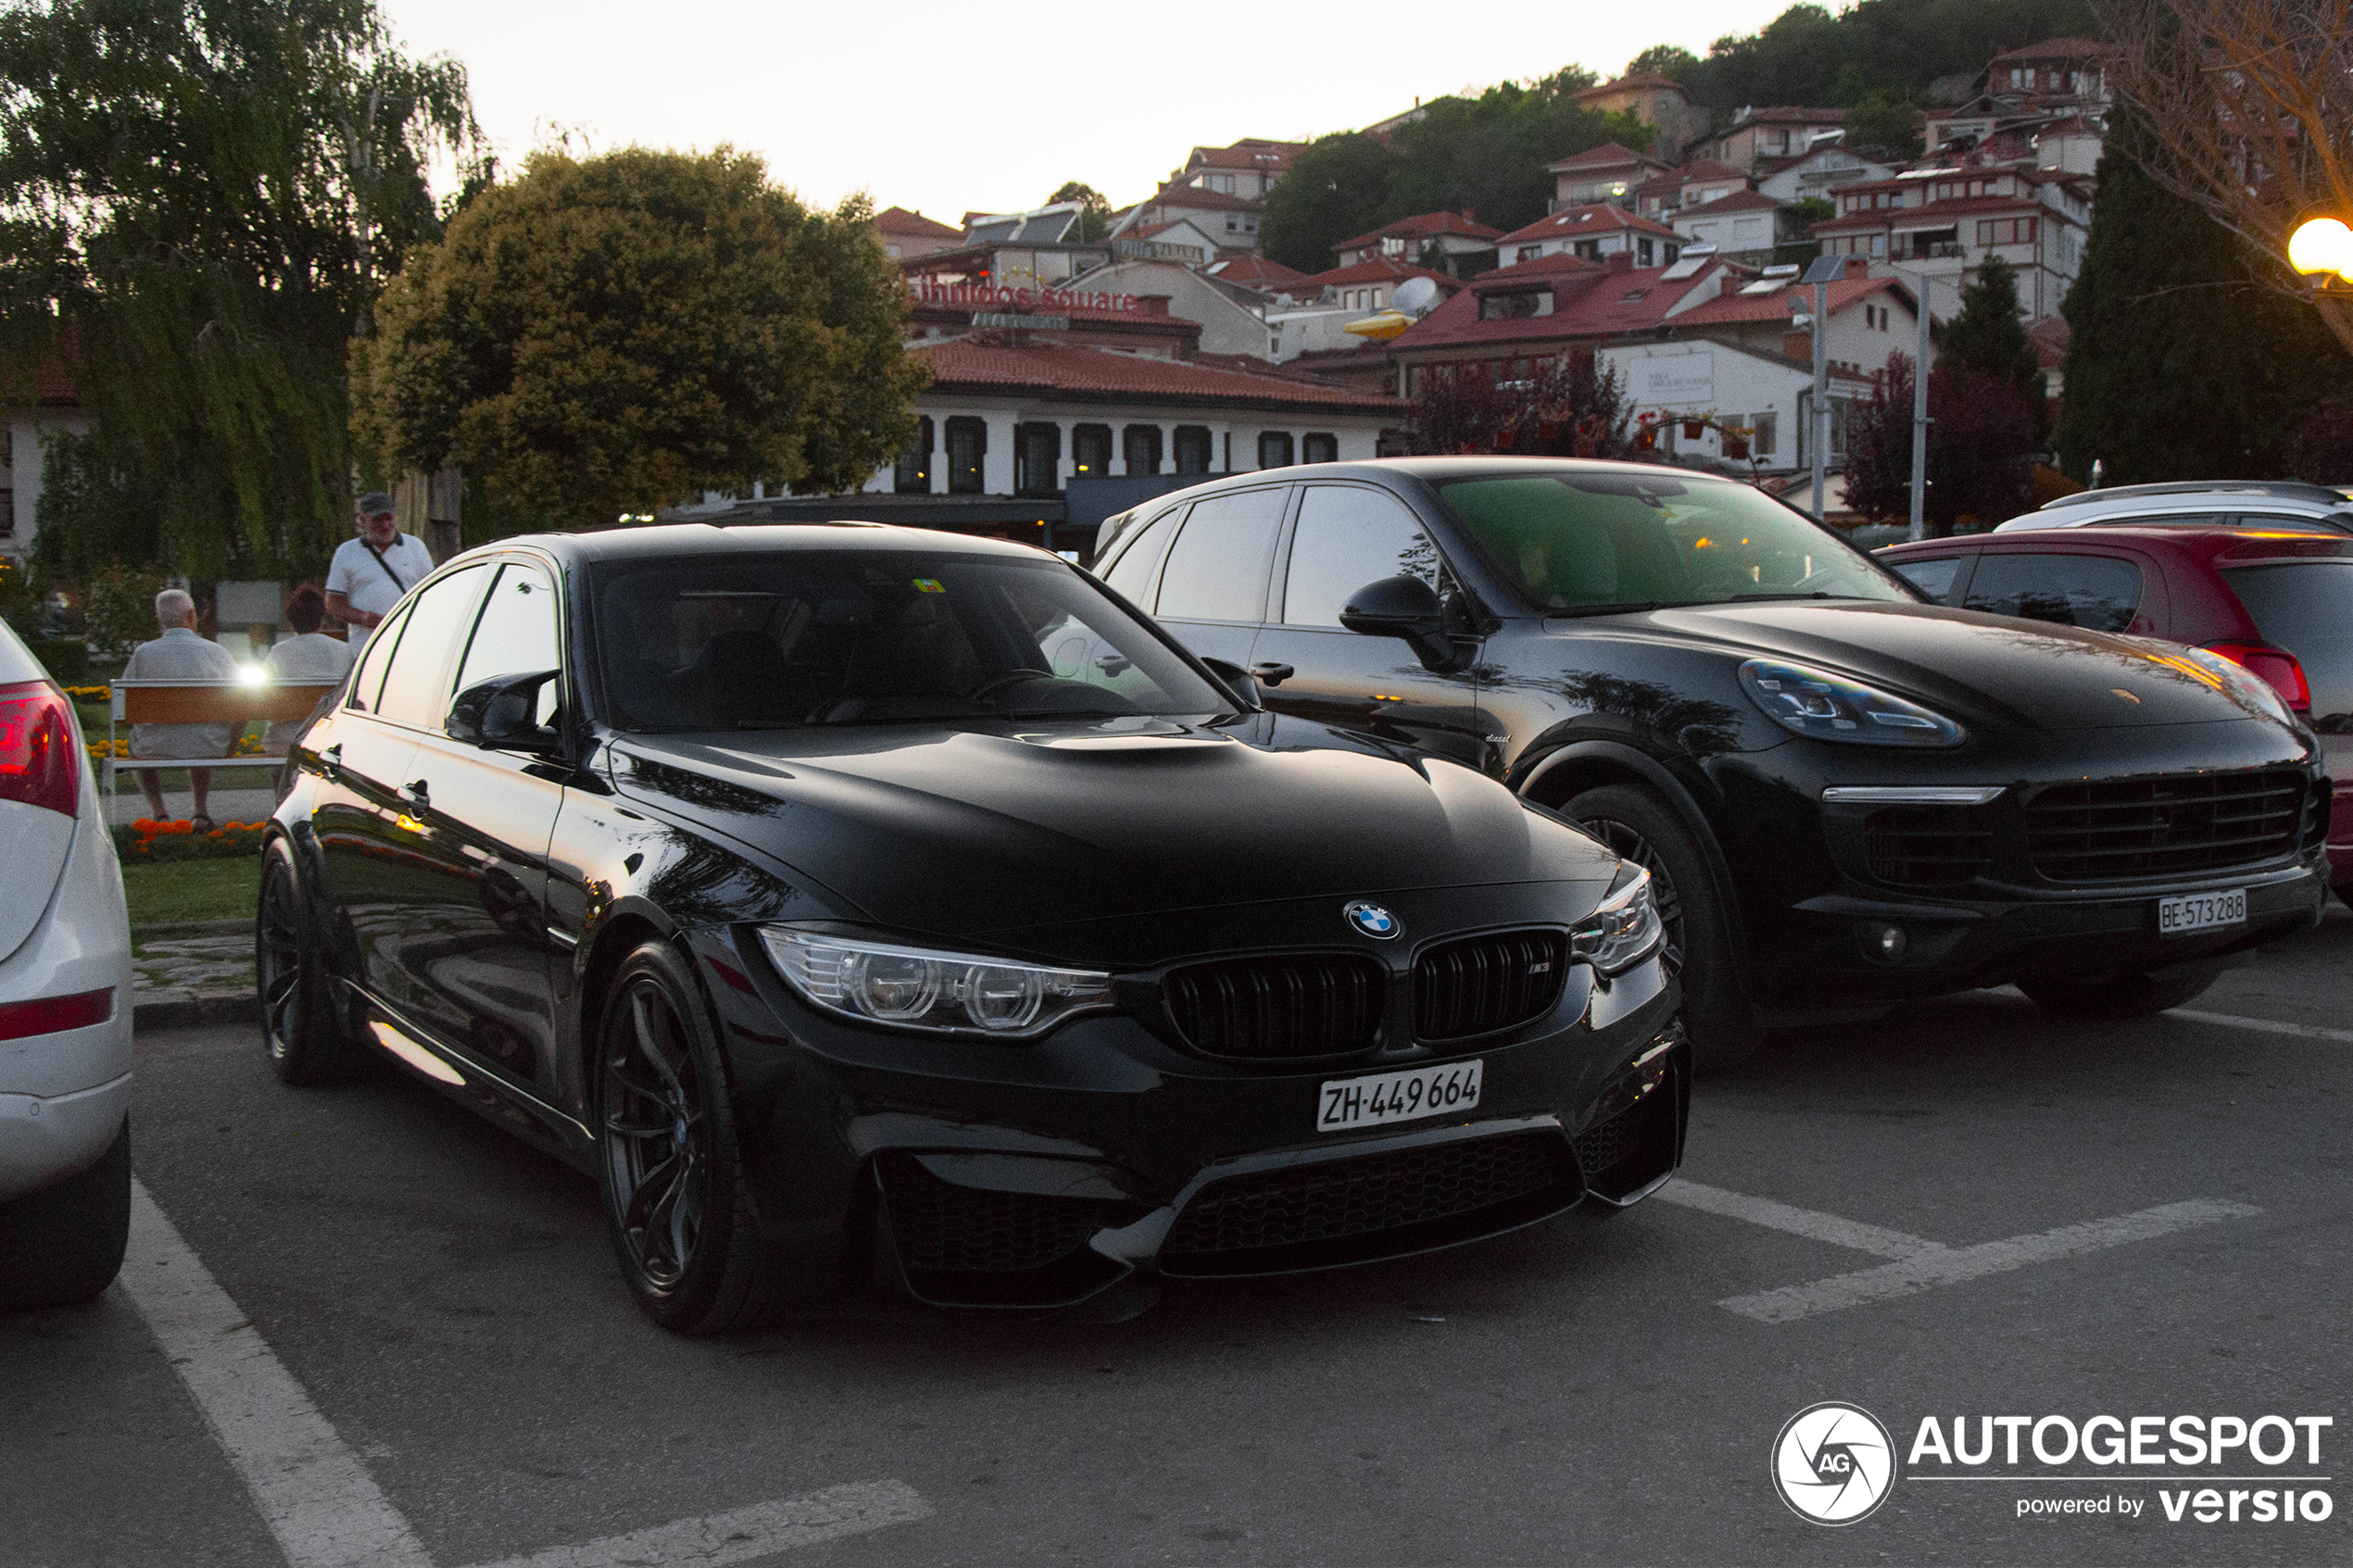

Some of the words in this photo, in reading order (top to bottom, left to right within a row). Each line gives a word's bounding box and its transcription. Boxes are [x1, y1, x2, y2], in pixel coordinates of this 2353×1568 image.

[909, 274, 1030, 307] ihnidos
[1041, 288, 1138, 318] square
[1352, 904, 1388, 917] BMW
